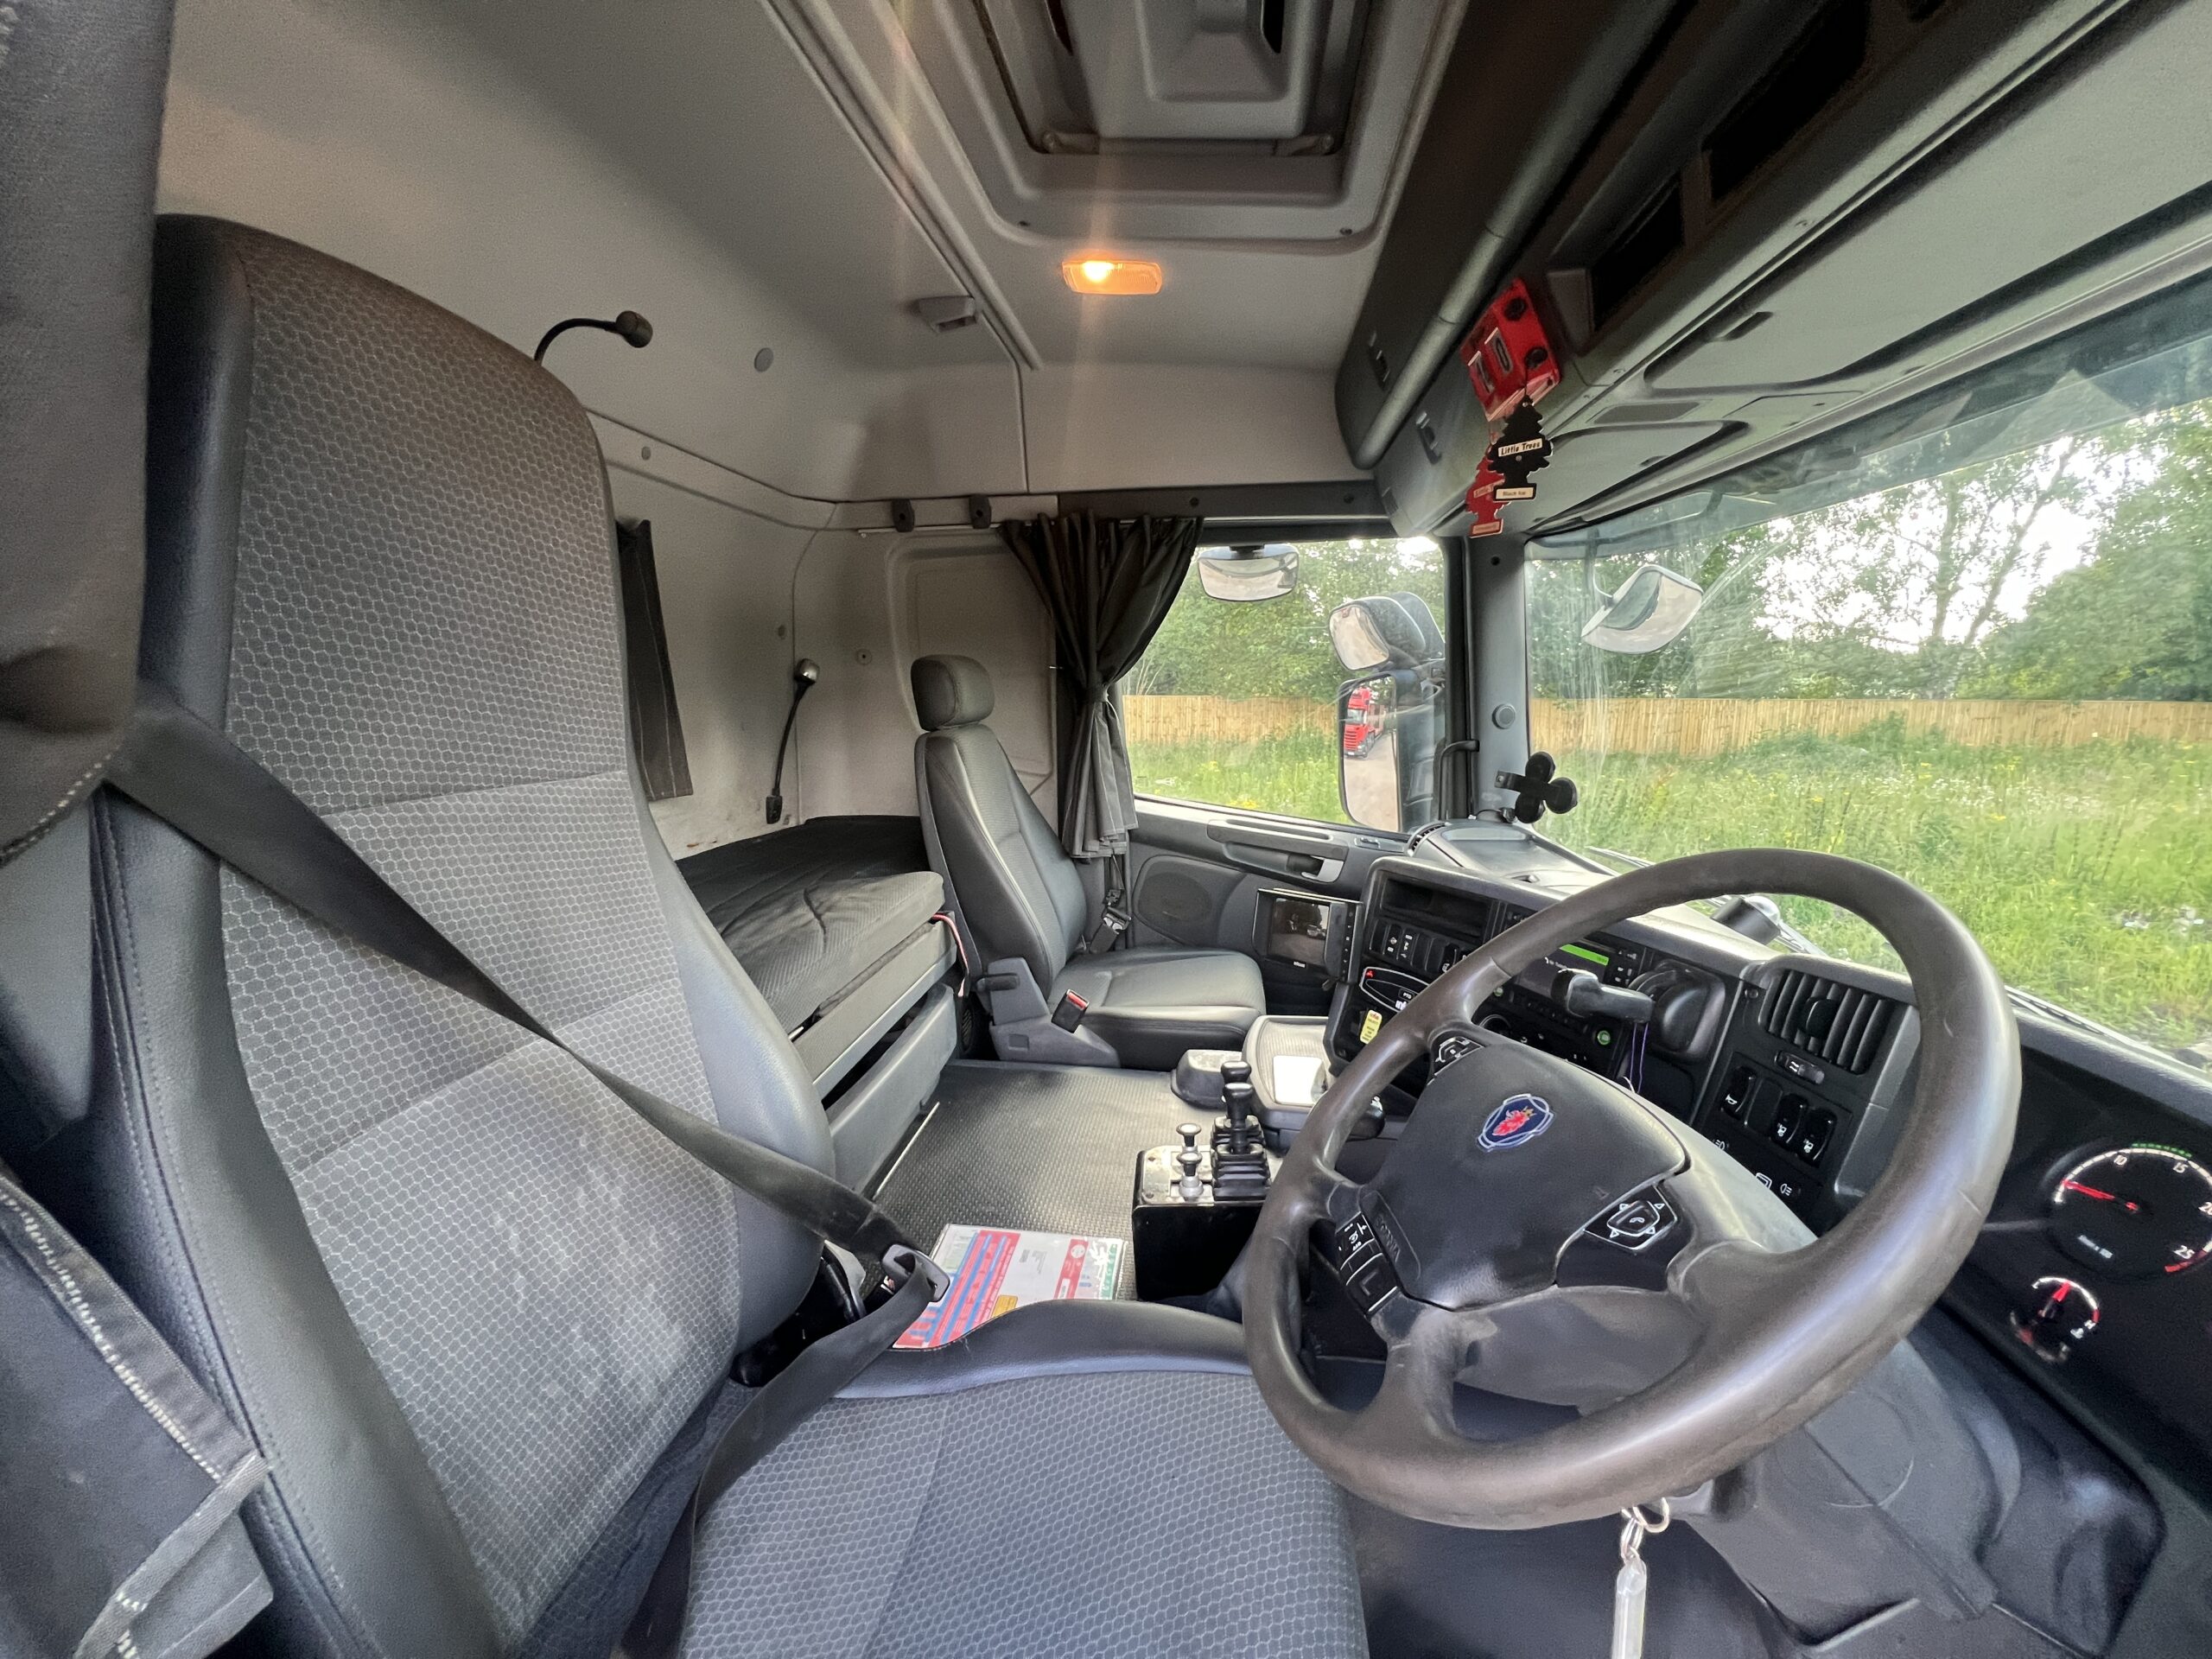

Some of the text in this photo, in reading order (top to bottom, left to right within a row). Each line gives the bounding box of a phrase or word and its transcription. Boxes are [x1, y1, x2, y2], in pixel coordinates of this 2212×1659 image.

[1501, 442, 1541, 455] Little Trees
[2113, 1154, 2128, 1166] 10
[2173, 1162, 2189, 1173] 15
[2174, 1245, 2196, 1260] 25
